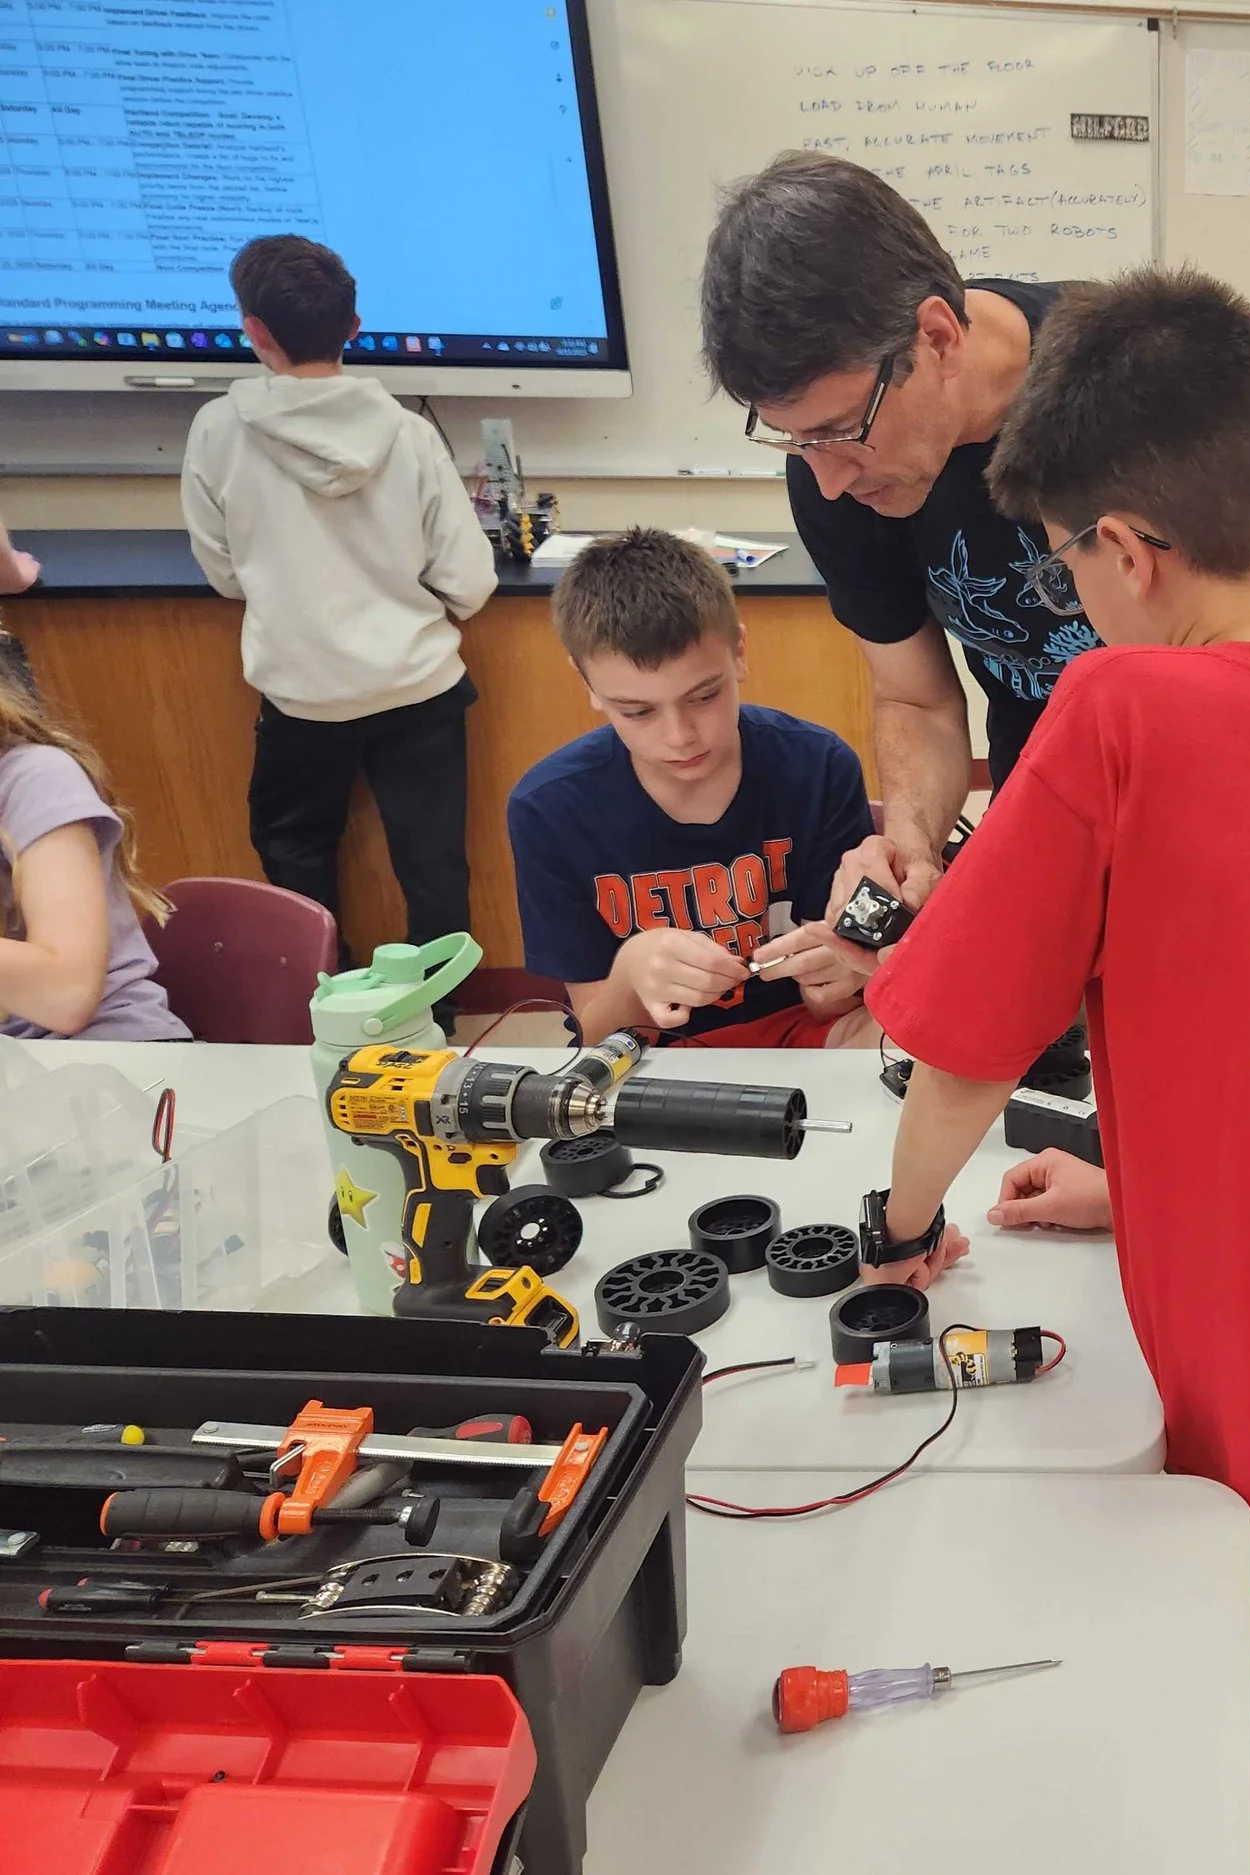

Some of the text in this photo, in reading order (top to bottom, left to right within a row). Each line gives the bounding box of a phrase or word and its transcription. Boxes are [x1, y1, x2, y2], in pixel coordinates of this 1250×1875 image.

[936, 61, 971, 76] THE
[984, 160, 1033, 177] TAGS
[991, 223, 1033, 238] TWO
[1049, 221, 1119, 240] ROBOTS
[53, 297, 142, 313] Programming
[145, 299, 197, 314] Meeting
